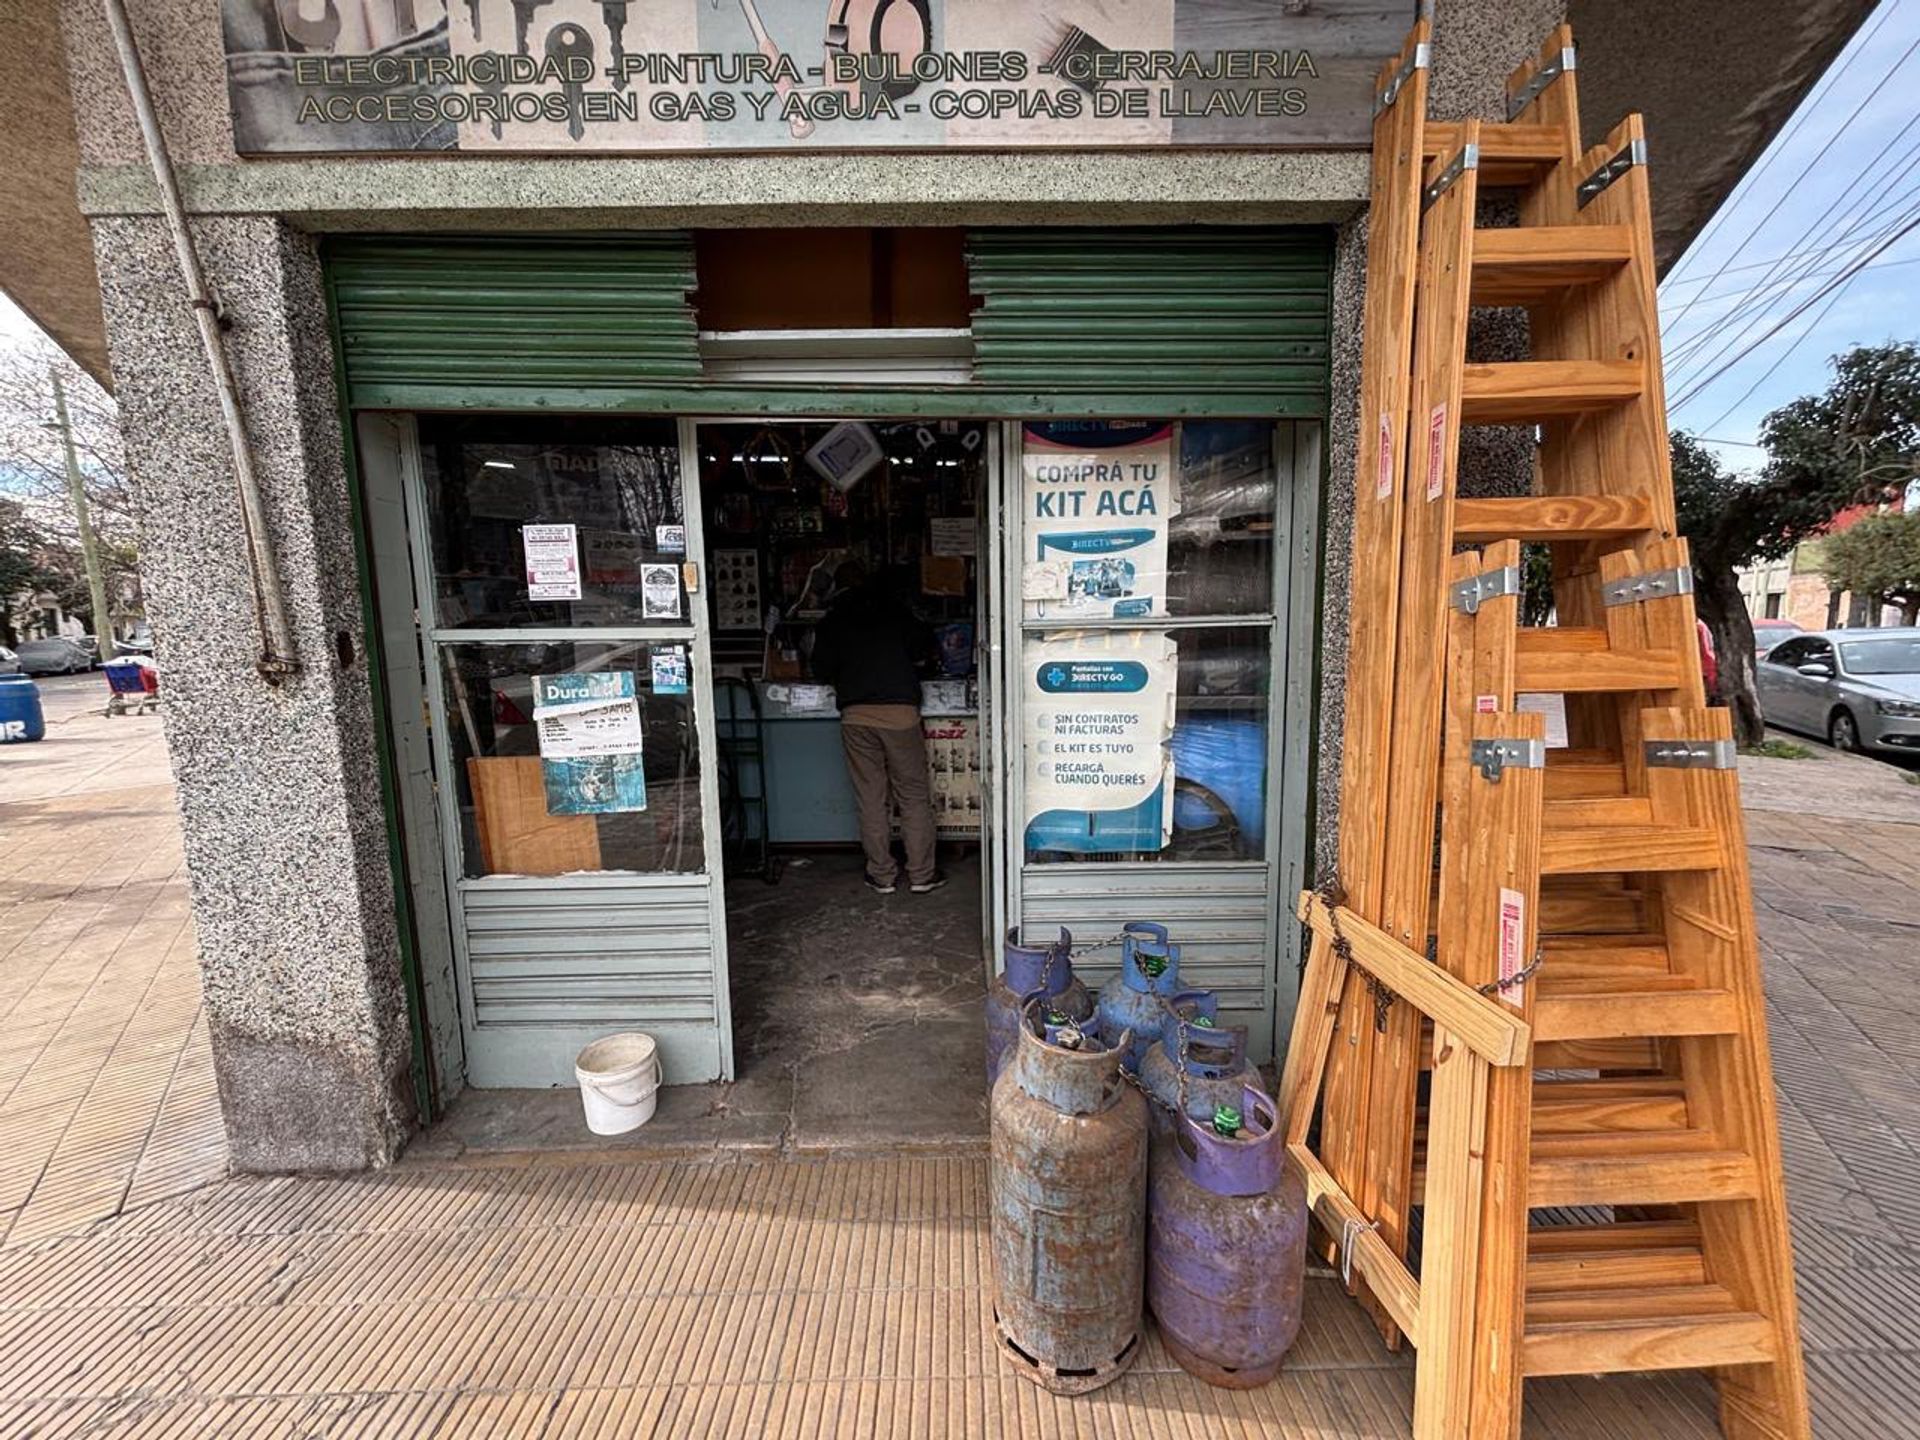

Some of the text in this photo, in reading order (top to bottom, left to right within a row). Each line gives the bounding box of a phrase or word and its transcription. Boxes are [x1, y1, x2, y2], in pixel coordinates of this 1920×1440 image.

[294, 54, 595, 86] ELECTRICIDAD
[833, 52, 1029, 82] BULONES
[1063, 49, 1319, 81] CERRAJERIA
[297, 93, 570, 124] ACCESORIOS
[582, 92, 638, 122] EN
[650, 91, 735, 121] GAS
[742, 91, 775, 121] Y
[780, 89, 900, 121] AGUA
[929, 89, 1082, 119] COPIAS
[1094, 88, 1149, 118] DE
[1160, 88, 1307, 117] LLAVES
[1036, 461, 1157, 483] COMPRÁ TU
[1036, 484, 1156, 517] KIT ACÁ
[1054, 714, 1139, 725] SIN CONTRATOS
[1054, 725, 1124, 735] NI FACTURAS
[1054, 743, 1134, 754] EL KIT ES TUYO
[1055, 774, 1100, 785] CUANDO
